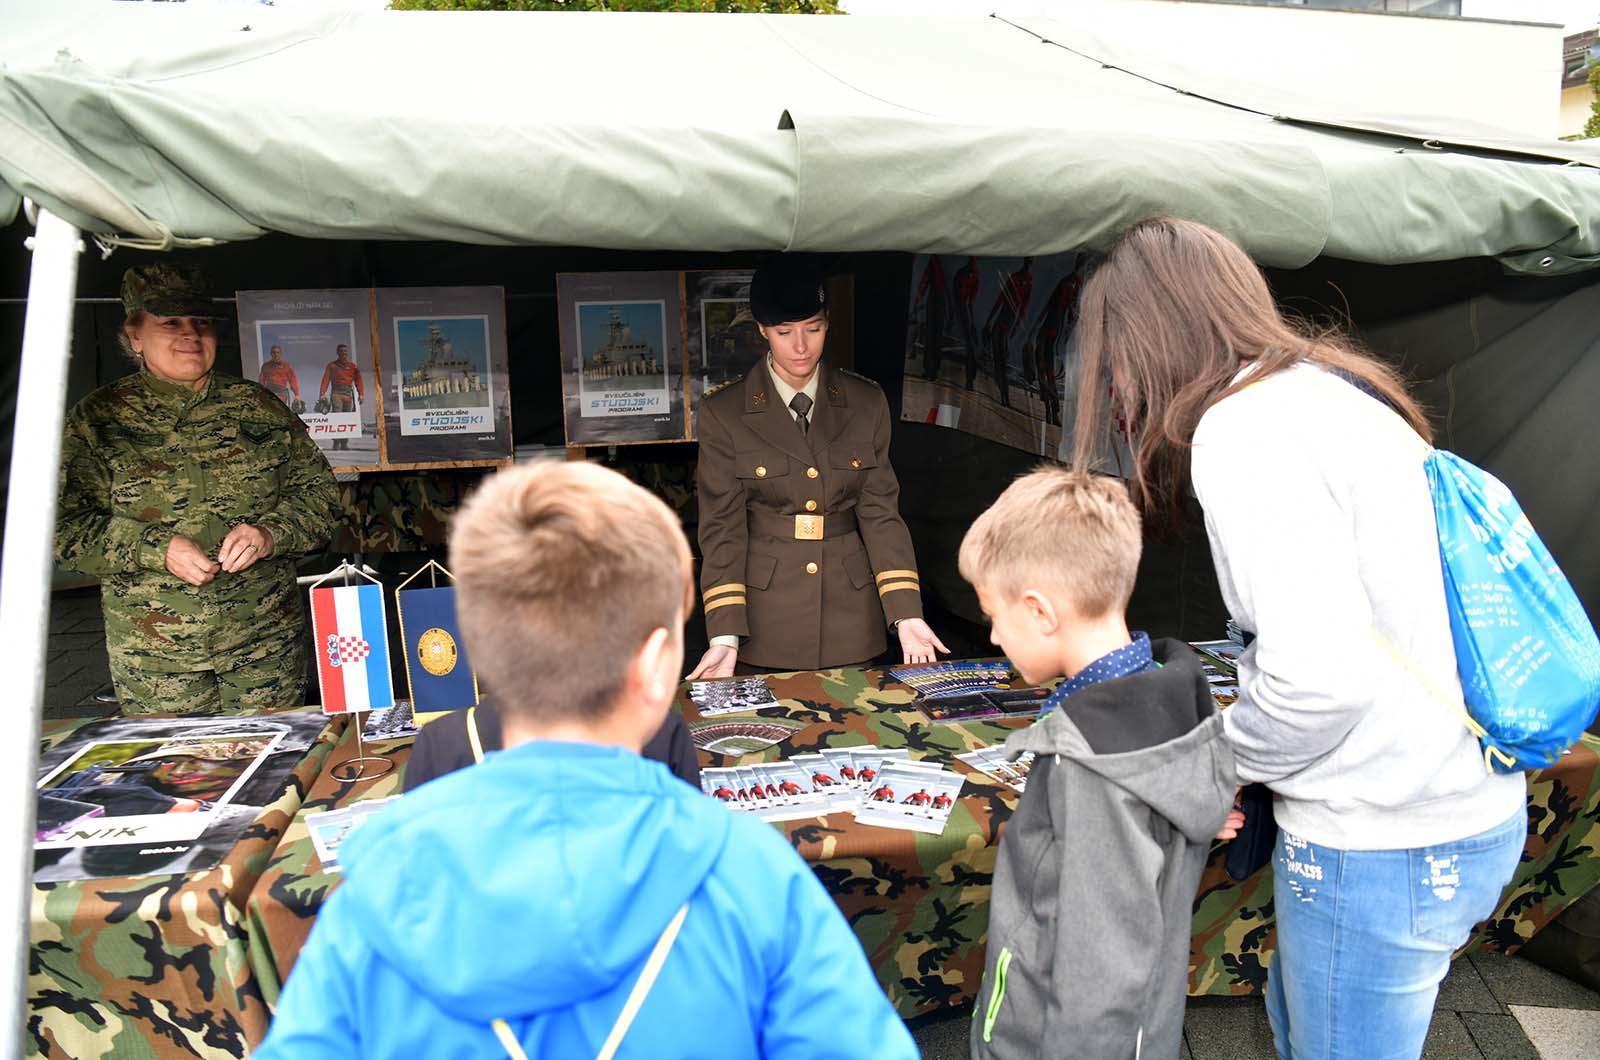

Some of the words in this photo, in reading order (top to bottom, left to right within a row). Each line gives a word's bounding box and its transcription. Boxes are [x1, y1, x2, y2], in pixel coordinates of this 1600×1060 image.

[591, 398, 659, 408] STUDIJSKI
[411, 416, 484, 426] STUDIJSKI
[315, 424, 357, 433] PILOT
